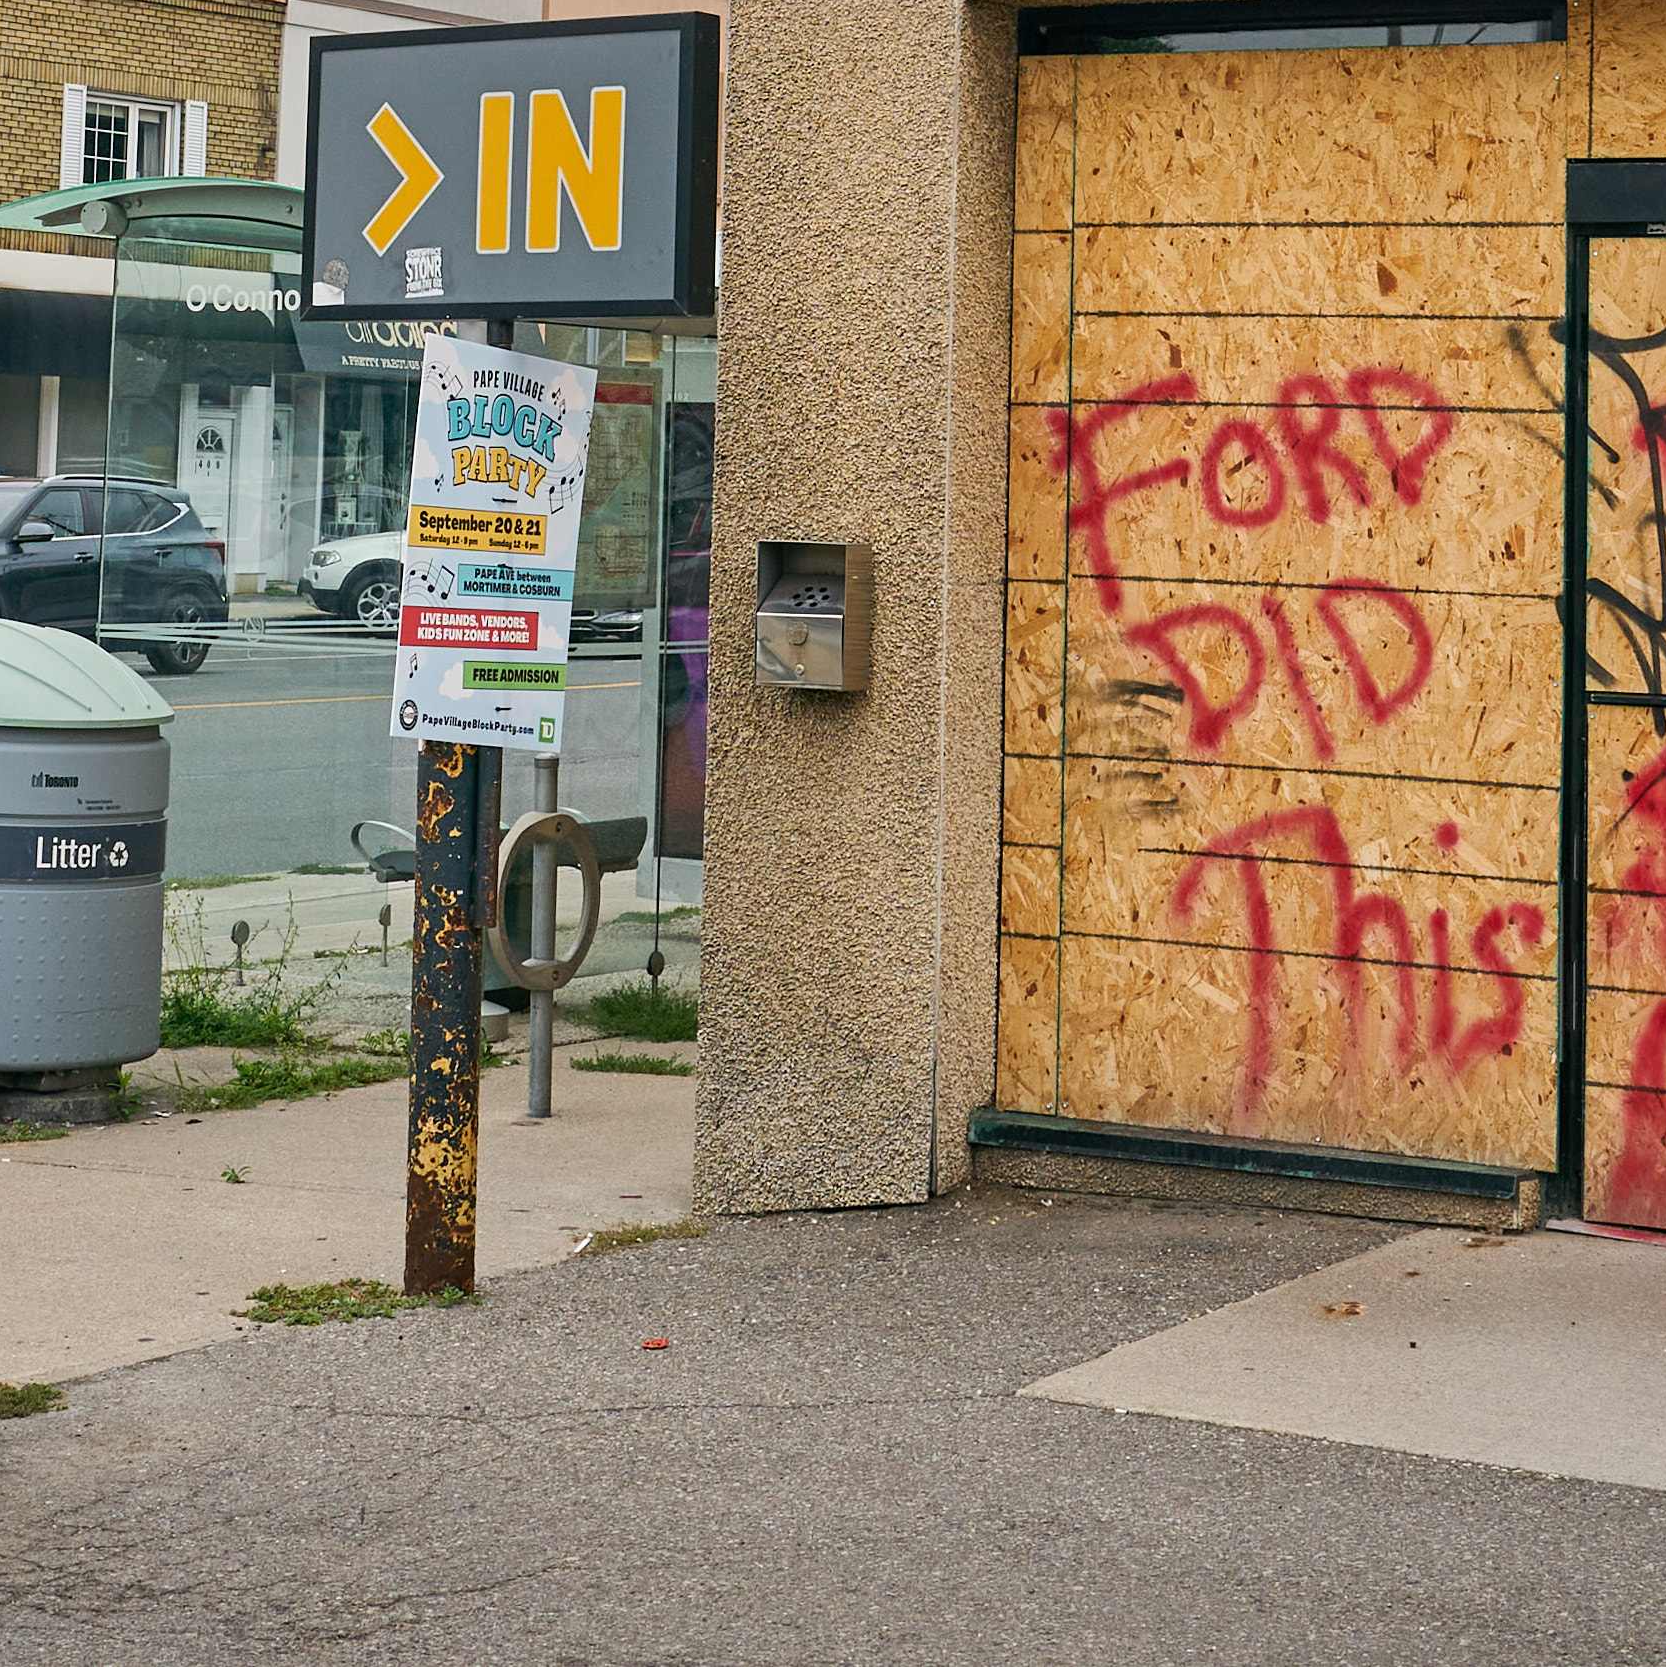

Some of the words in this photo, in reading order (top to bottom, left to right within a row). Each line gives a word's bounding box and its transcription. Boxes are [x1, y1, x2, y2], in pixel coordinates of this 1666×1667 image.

[475, 85, 626, 254] IN
[185, 284, 301, 312] O'Conno
[474, 370, 499, 388] PAPE
[503, 372, 545, 402] VILLAGE
[448, 394, 563, 462] BLOCK
[452, 445, 547, 498] PARTY
[1044, 368, 1456, 614] FORD
[419, 511, 492, 533] September
[495, 517, 511, 534] 20
[514, 519, 524, 535] &
[525, 519, 541, 536] 21
[419, 534, 450, 546] Saturday
[489, 538, 512, 549] Sunday
[475, 568, 497, 579] PAPE
[499, 569, 515, 581] AVE
[517, 571, 551, 583] between
[464, 581, 511, 594] MORTIMER
[519, 584, 561, 597] COSBURN
[420, 612, 442, 625] LIVE
[443, 613, 479, 628] BANDS,
[418, 627, 442, 640] KIDS
[443, 628, 463, 641] FUN
[464, 629, 490, 642] ZONE
[492, 631, 500, 642] &
[500, 631, 530, 644] MORE!
[473, 668, 499, 682] FREE
[500, 669, 559, 684] ADMISSION
[1128, 578, 1435, 762] DID
[422, 714, 535, 736] PapeVillageBlockParty.com
[541, 720, 555, 739] TD
[44, 774, 79, 787] TORONTO
[36, 836, 102, 869] Litter
[1173, 804, 1544, 1124] This
